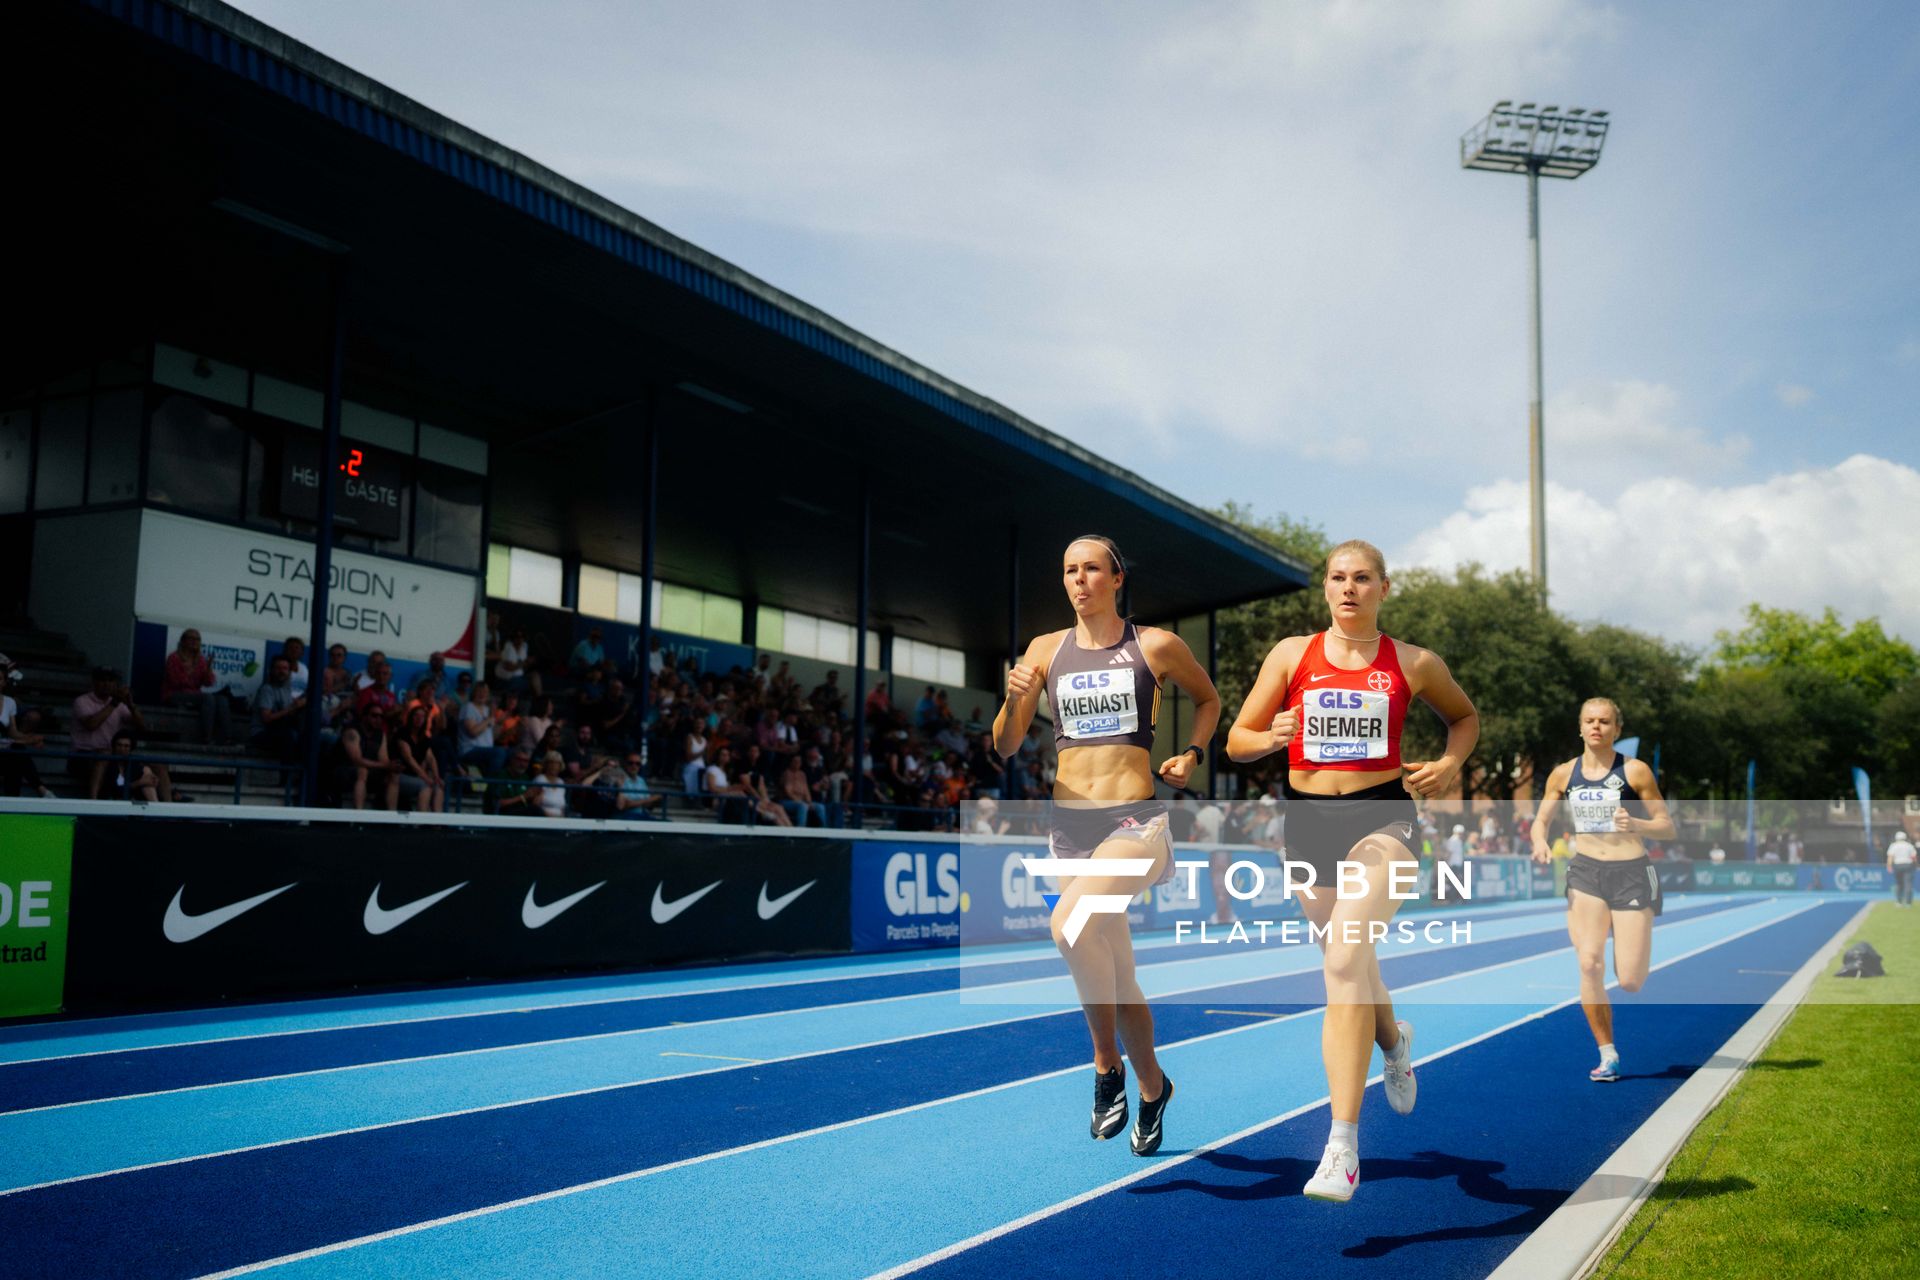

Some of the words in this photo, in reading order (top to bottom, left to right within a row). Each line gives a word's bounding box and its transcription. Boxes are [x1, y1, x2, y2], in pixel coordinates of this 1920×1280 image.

[291, 465, 320, 488] HEI
[1062, 693, 1130, 717] KIENAST
[1094, 718, 1118, 728] PLAN
[1308, 716, 1382, 738] SIEMER
[1340, 745, 1366, 754] PLAN
[887, 924, 920, 940] Parcels
[921, 925, 930, 938] to
[931, 922, 960, 940] People
[1, 941, 47, 963] trad
